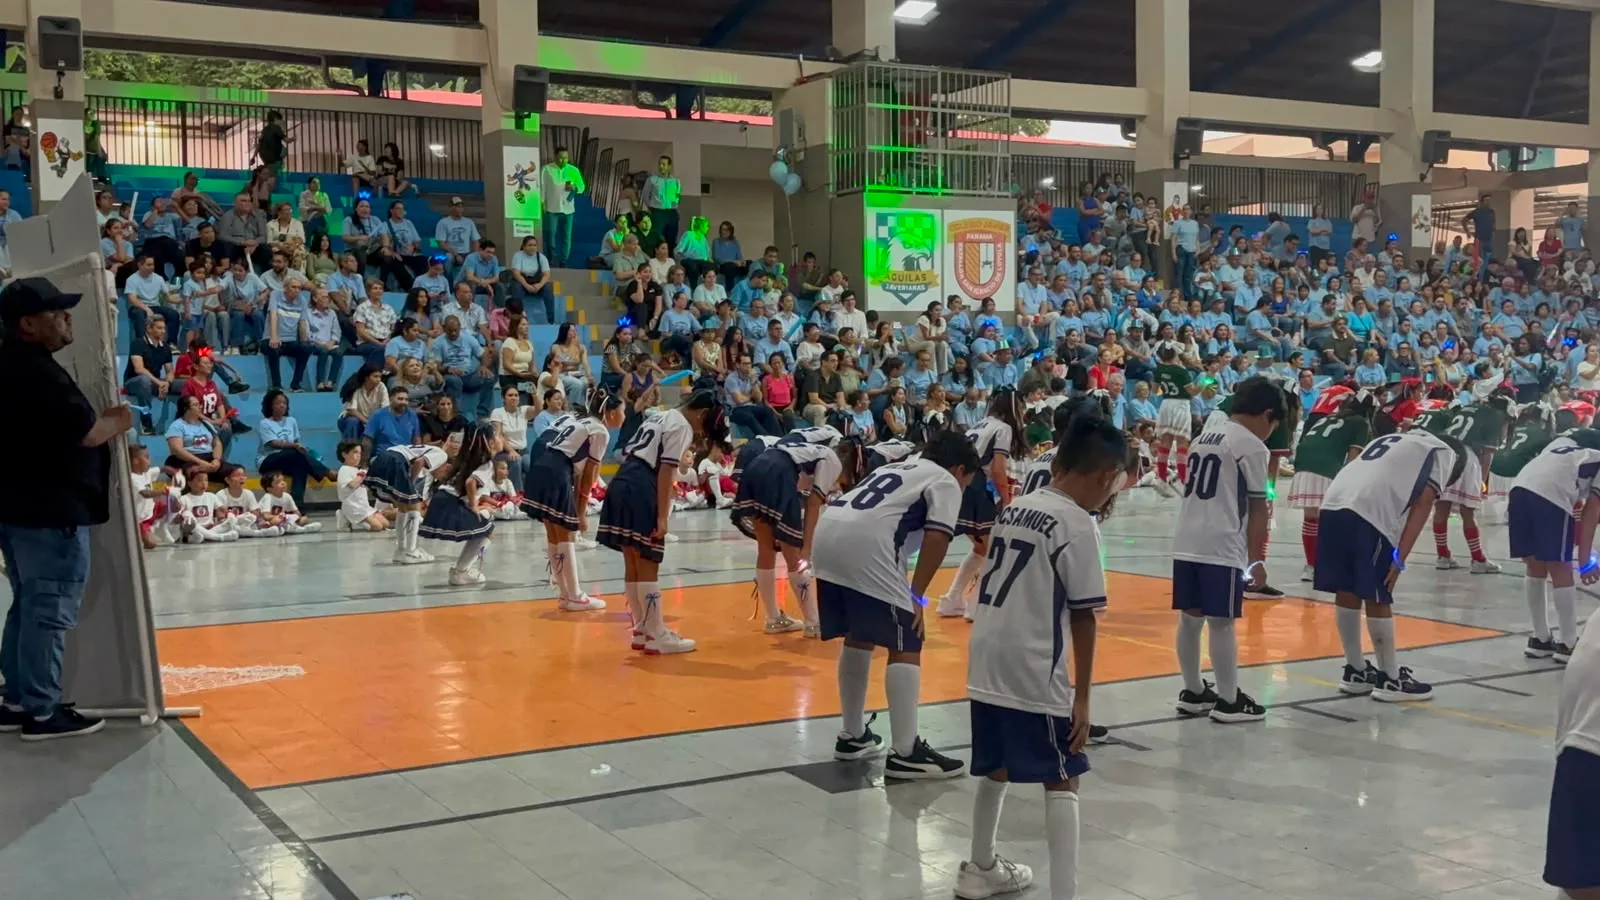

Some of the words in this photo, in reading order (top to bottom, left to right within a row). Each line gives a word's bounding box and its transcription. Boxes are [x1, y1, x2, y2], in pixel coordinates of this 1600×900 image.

[1198, 432, 1226, 446] LIAM
[1360, 435, 1403, 461] 6
[1184, 452, 1222, 500] 30
[978, 536, 1036, 609] 27
